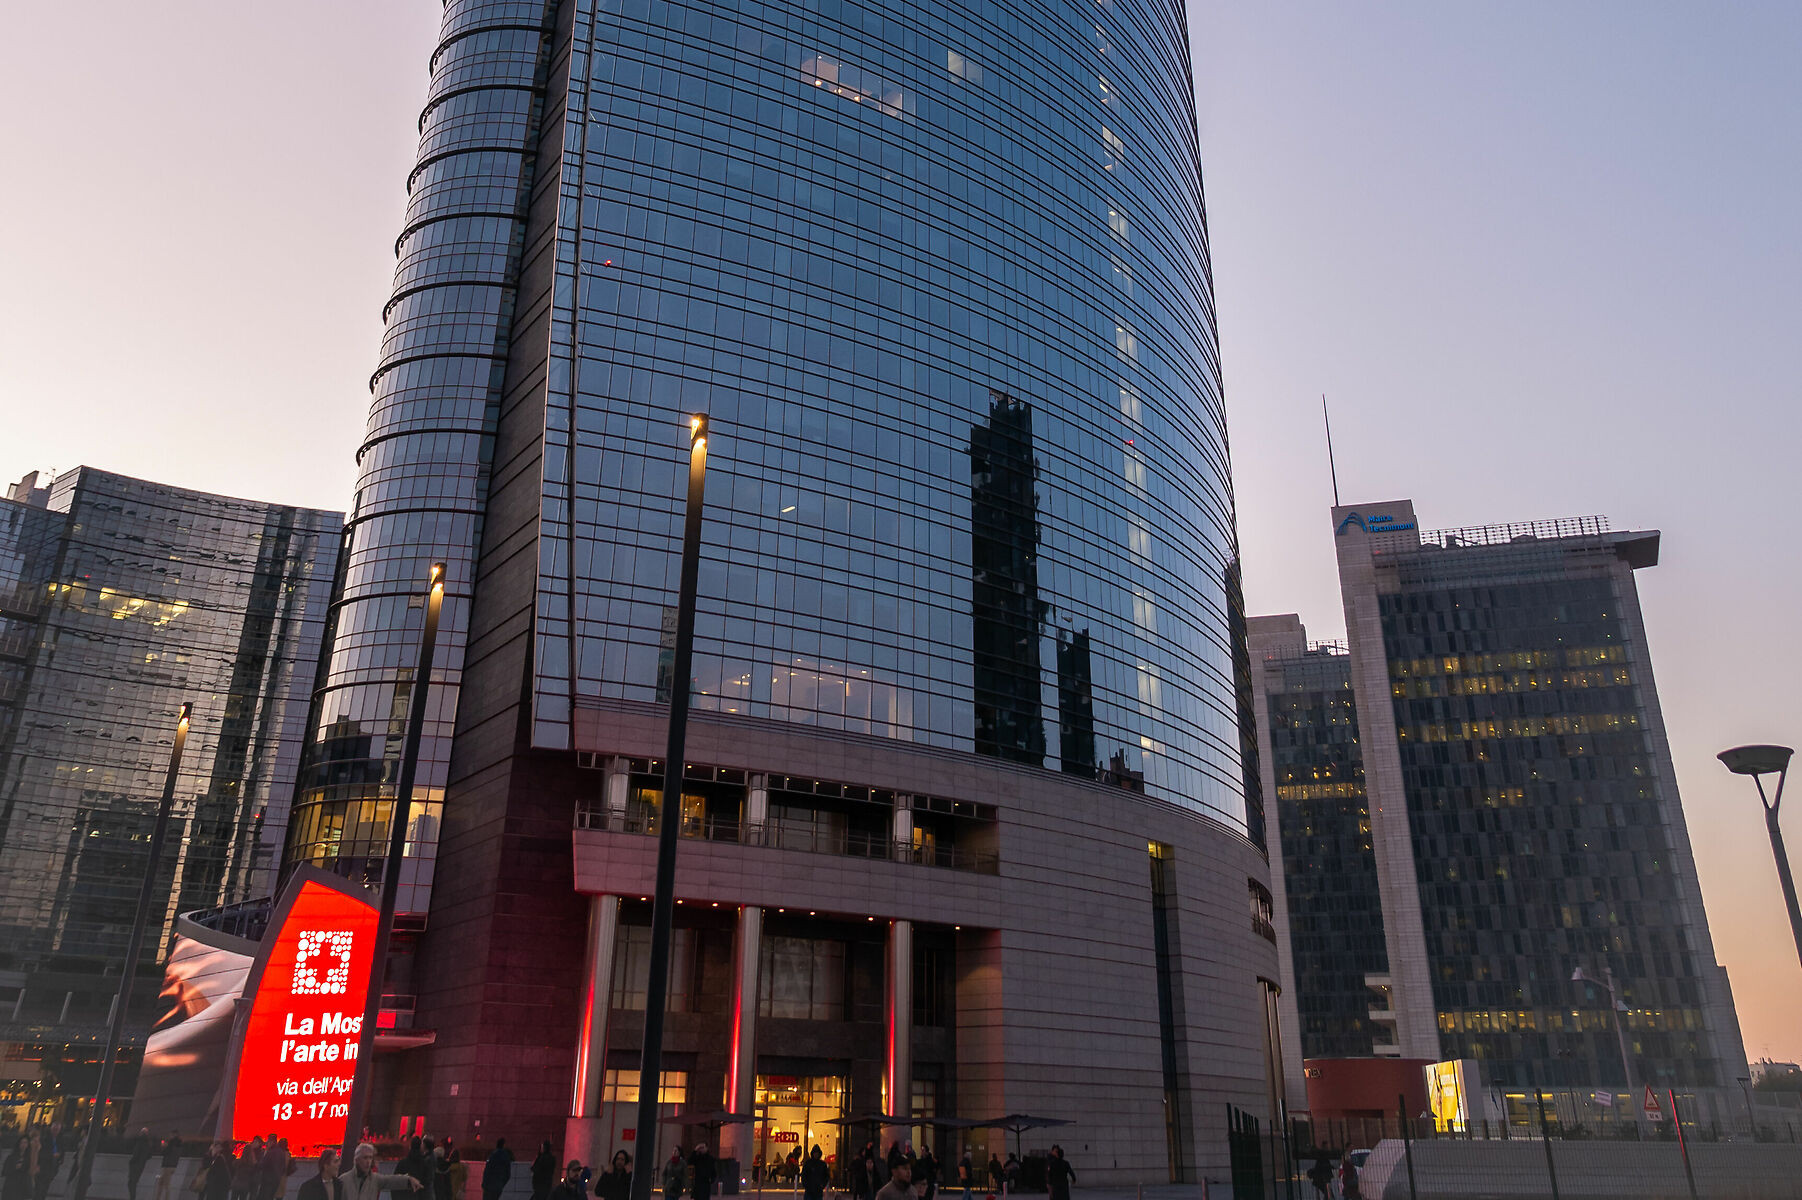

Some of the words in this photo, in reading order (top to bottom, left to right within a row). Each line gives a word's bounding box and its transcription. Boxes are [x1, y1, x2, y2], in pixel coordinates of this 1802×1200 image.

[284, 1012, 315, 1035] La
[320, 1011, 365, 1035] Mos
[280, 1039, 340, 1063] l'arte
[343, 1038, 359, 1061] in
[276, 1078, 299, 1096] via
[272, 1102, 293, 1121] 13
[308, 1101, 329, 1120] 17
[774, 1131, 800, 1143] RED
